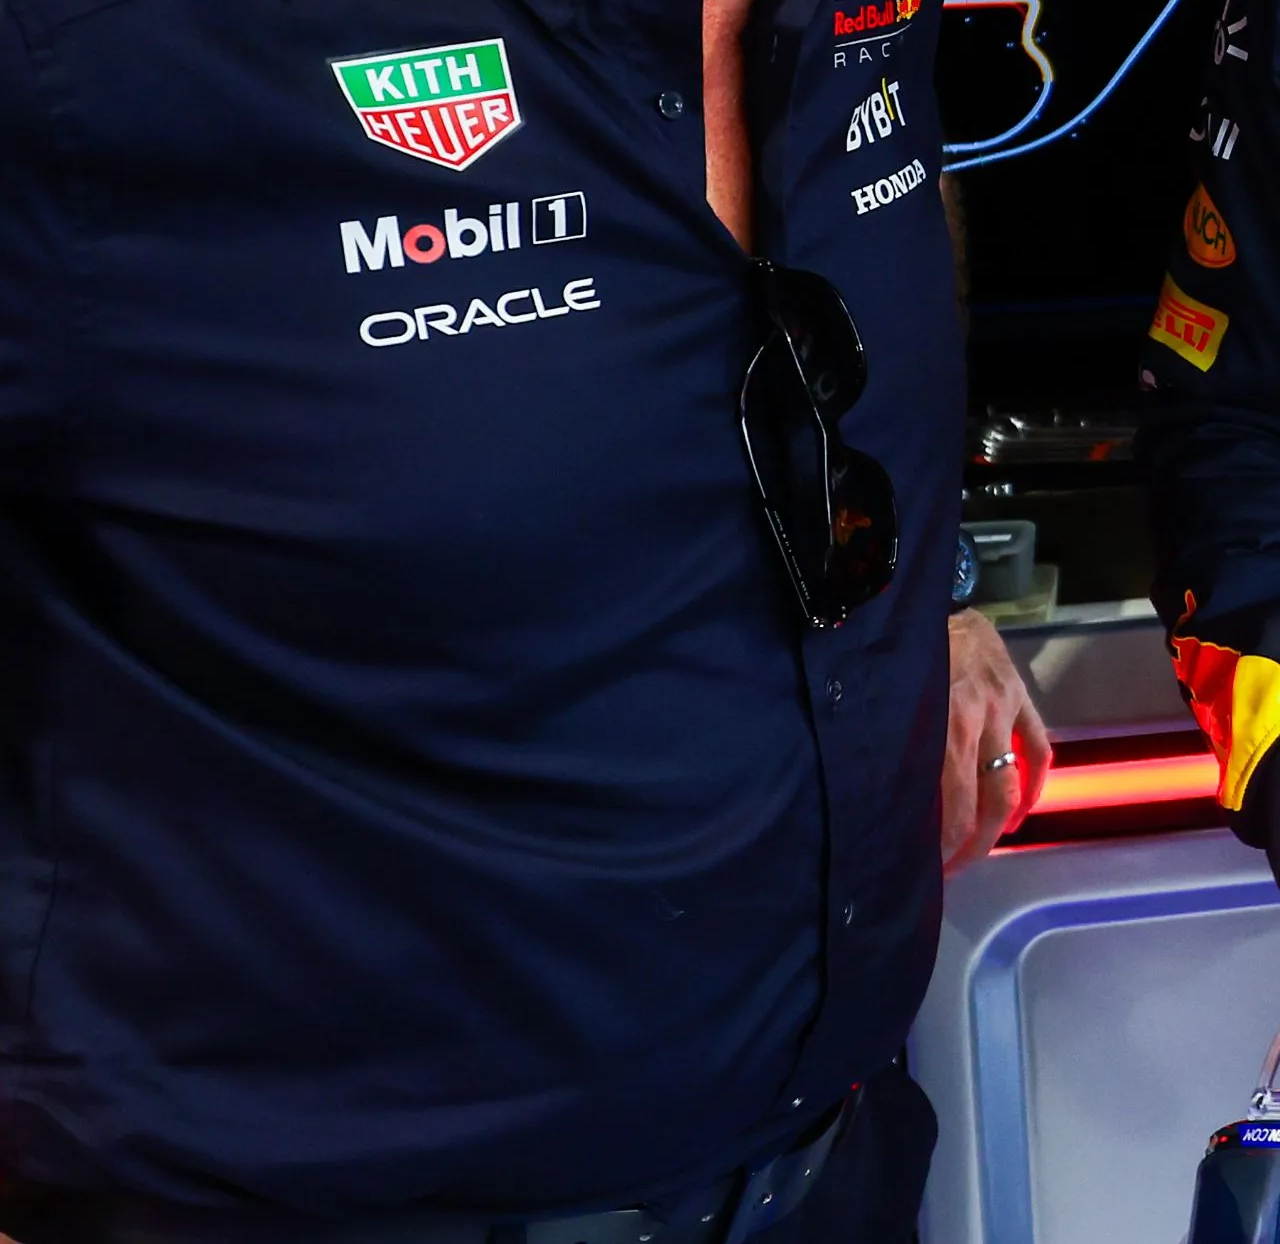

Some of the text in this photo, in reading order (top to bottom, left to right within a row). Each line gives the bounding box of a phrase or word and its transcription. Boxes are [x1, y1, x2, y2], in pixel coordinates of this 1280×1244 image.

[834, 0, 894, 36] Red Bull
[366, 52, 483, 101] KITH
[834, 42, 892, 68] RAC
[366, 97, 512, 163] HEUER
[846, 78, 906, 152] BYBIT
[851, 159, 927, 215] HONDA
[340, 201, 520, 275] Mobil
[1191, 202, 1227, 255] UCH
[359, 279, 600, 347] ORACLE
